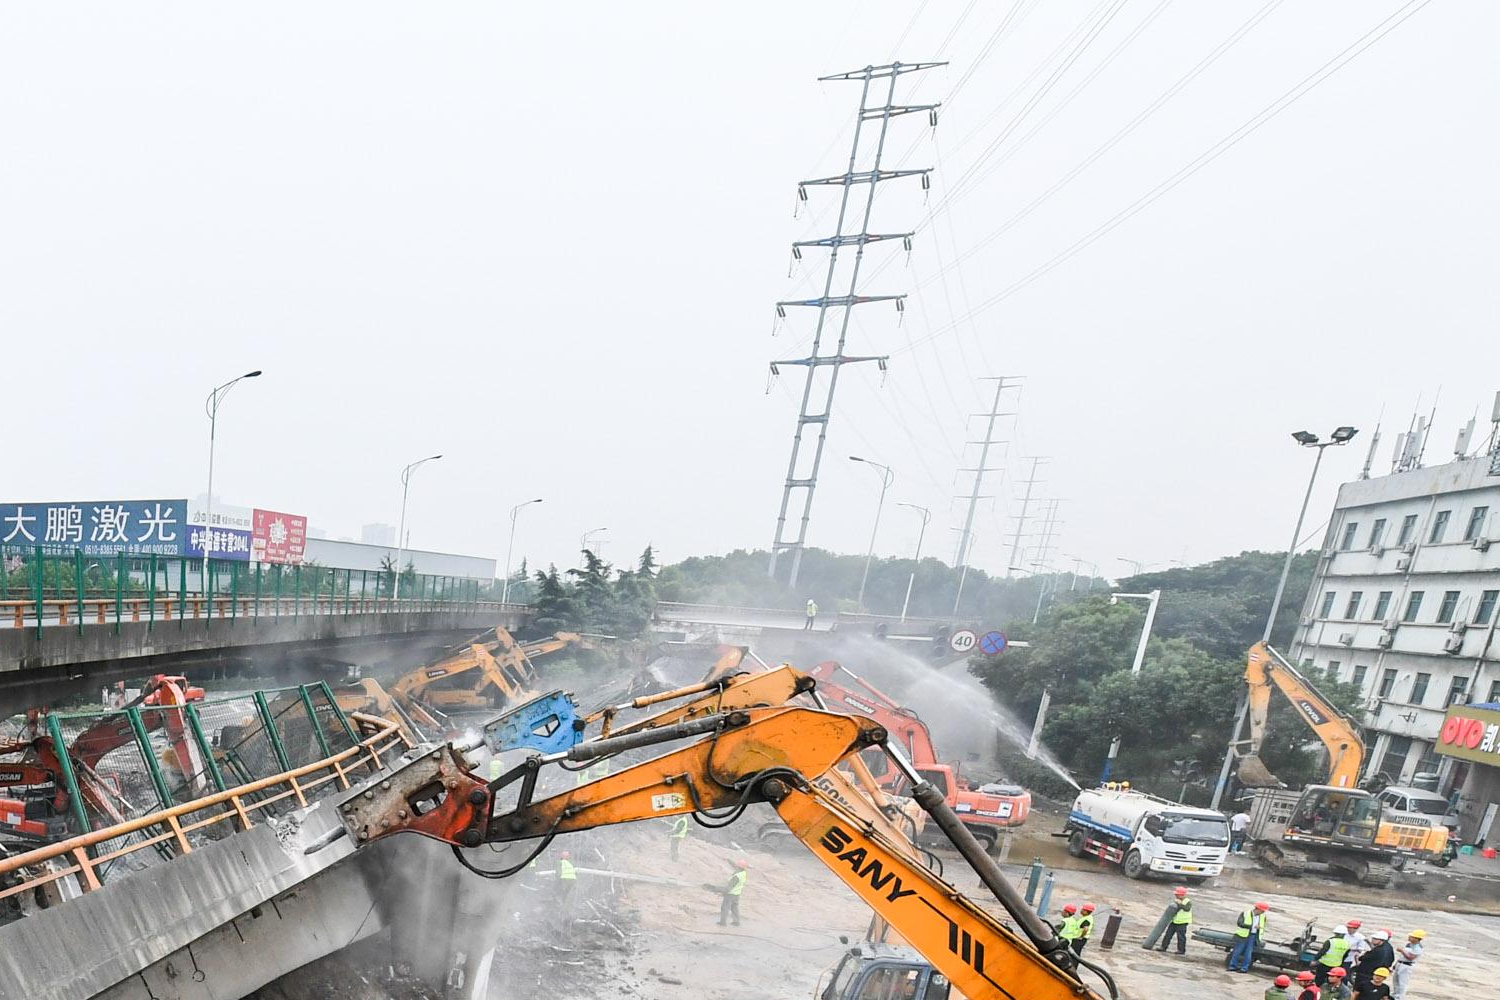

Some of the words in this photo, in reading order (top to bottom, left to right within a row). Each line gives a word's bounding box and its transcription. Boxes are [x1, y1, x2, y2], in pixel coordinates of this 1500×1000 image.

[3, 503, 177, 543] 大鹏激光
[955, 636, 971, 647] 40
[1301, 702, 1320, 723] LOVOL
[1442, 717, 1484, 750] OYO
[1480, 723, 1500, 754] 凯
[820, 825, 917, 903] SANY
